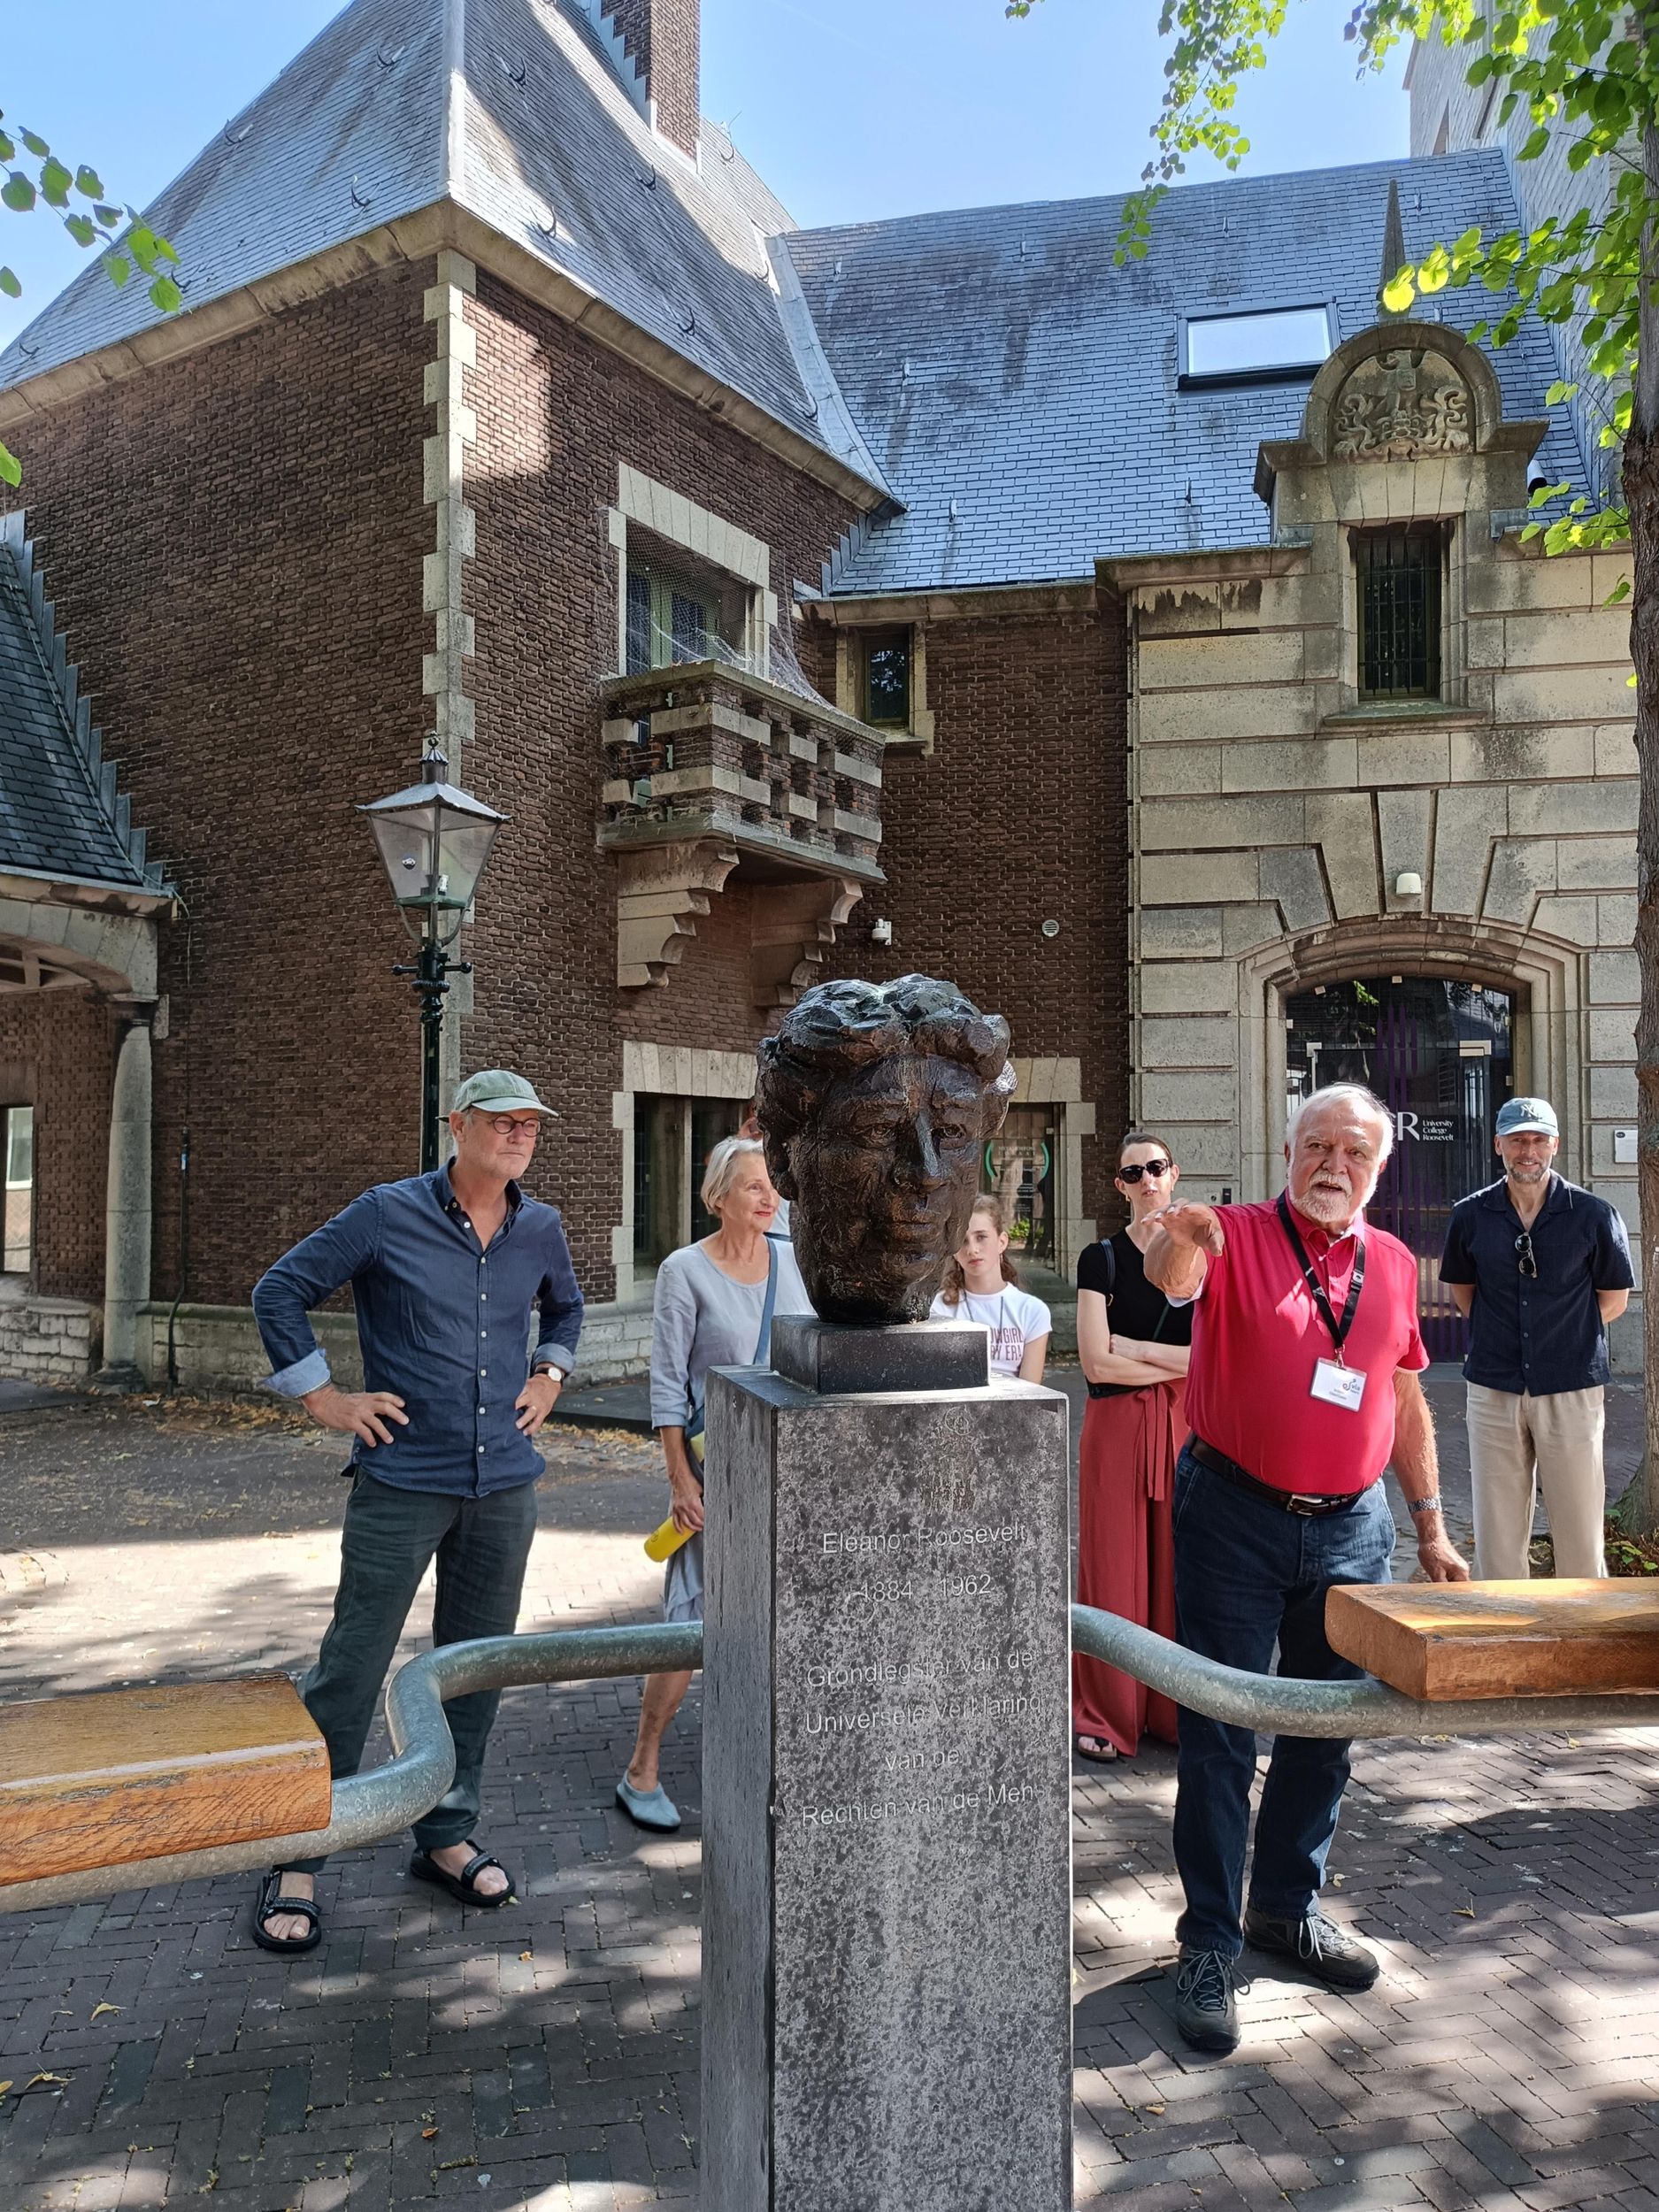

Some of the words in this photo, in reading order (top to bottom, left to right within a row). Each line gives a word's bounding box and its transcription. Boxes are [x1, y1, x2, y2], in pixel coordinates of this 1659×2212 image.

[1422, 1119, 1454, 1128] University
[1422, 1126, 1448, 1135] College
[822, 1531, 910, 1554] Eleanor
[917, 1522, 1026, 1548] Roosevelt
[860, 1579, 914, 1602] 1884
[938, 1573, 991, 1596] 1962
[807, 1658, 952, 1687] Grondlegster
[961, 1655, 1000, 1673] van
[1007, 1649, 1033, 1669] de
[805, 1703, 926, 1734] Universele
[885, 1753, 925, 1770] van
[802, 1800, 897, 1826] Rechten
[905, 1795, 944, 1814] van
[953, 1787, 979, 1809] de
